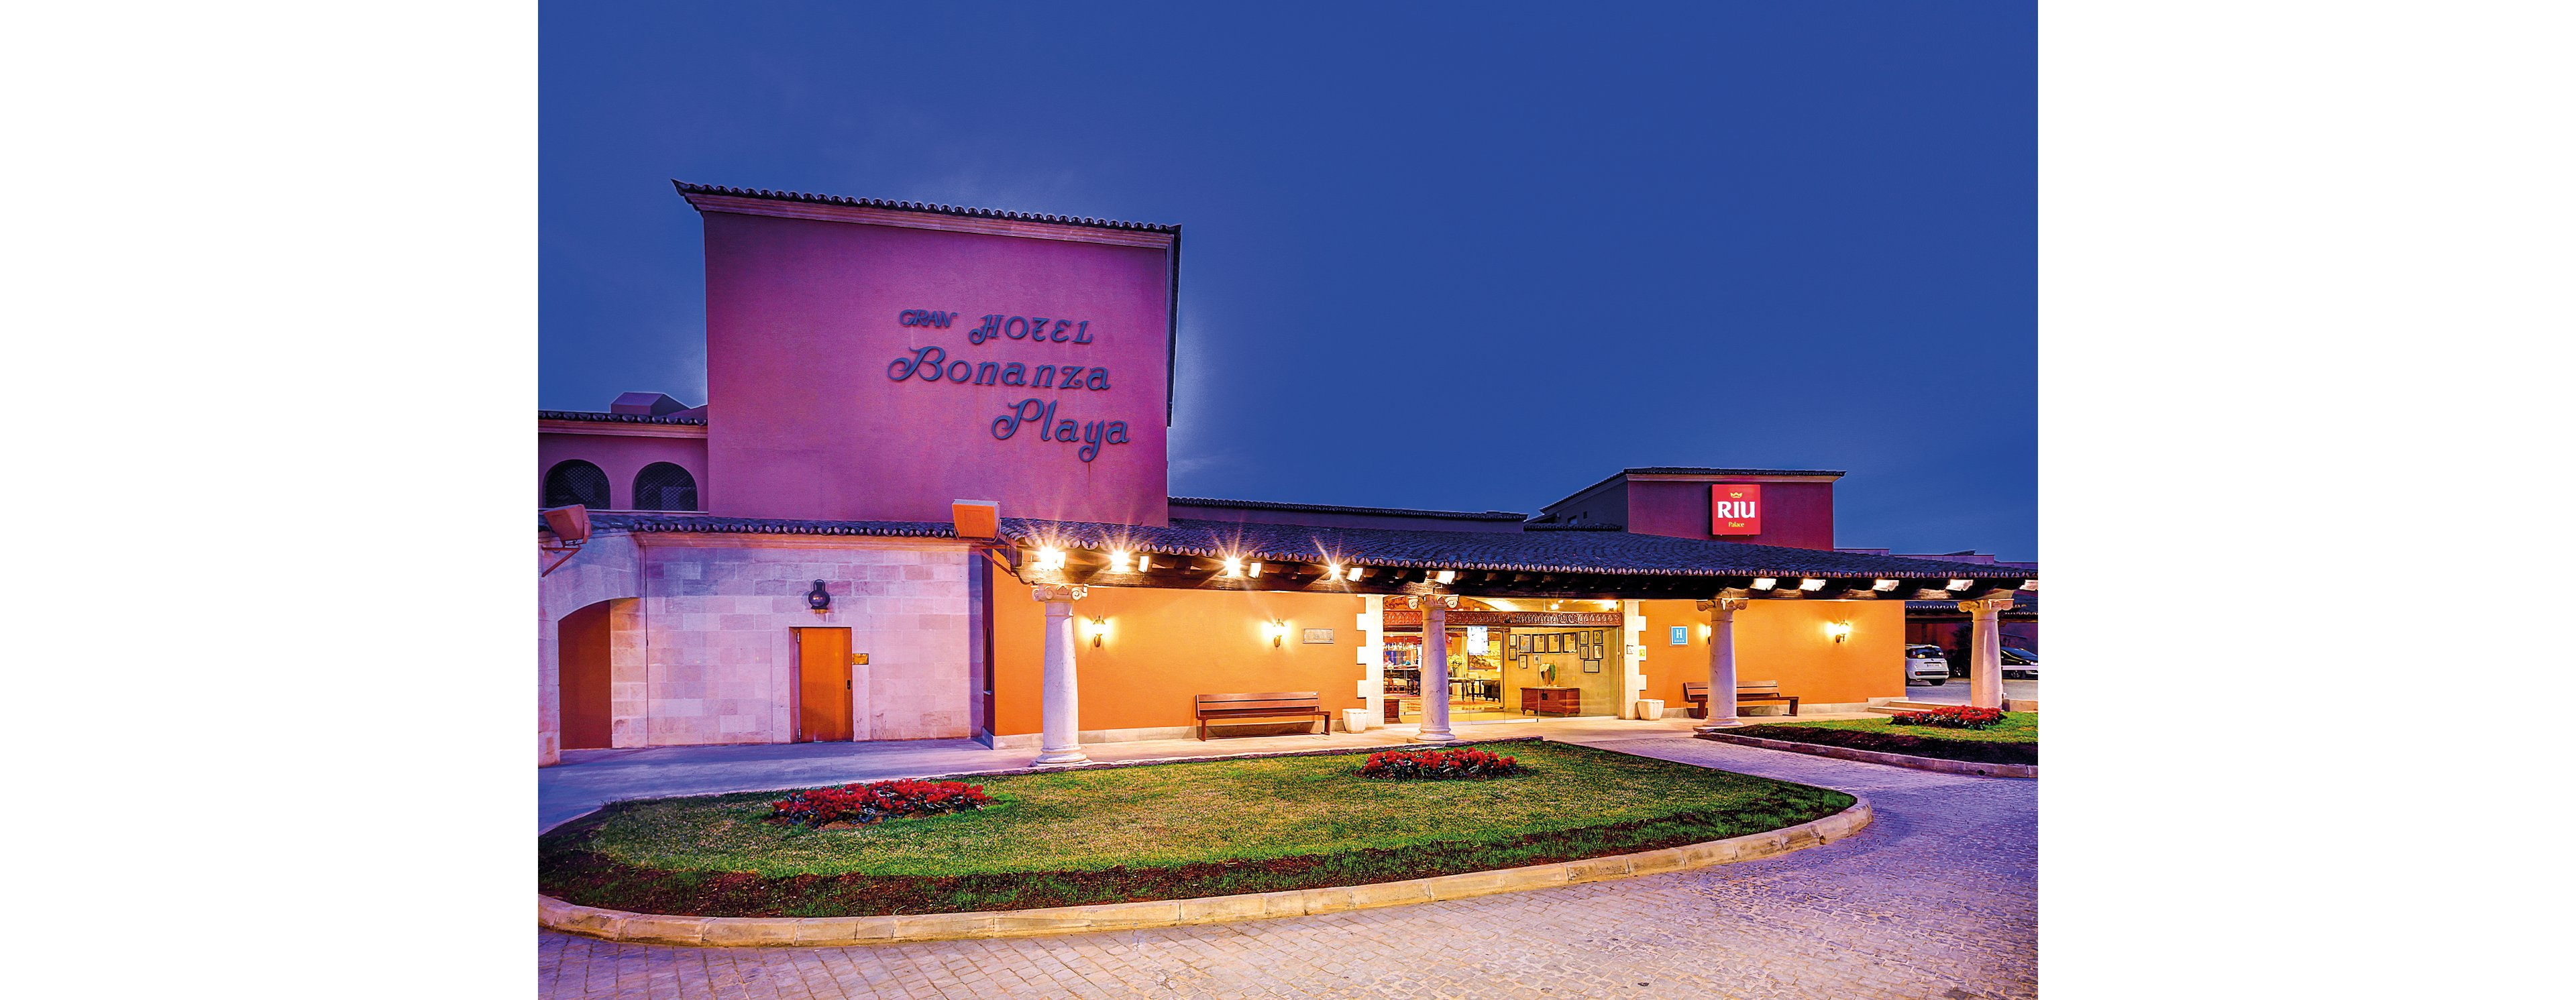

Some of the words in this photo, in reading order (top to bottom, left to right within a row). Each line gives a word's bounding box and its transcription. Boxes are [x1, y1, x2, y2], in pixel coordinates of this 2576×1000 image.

[899, 309, 957, 328] GRAN
[969, 314, 1093, 344] HOTEL
[888, 346, 1111, 390] Bonanza
[992, 398, 1130, 462] Playa
[1717, 501, 1756, 518] RIU
[1676, 629, 1682, 638] H
